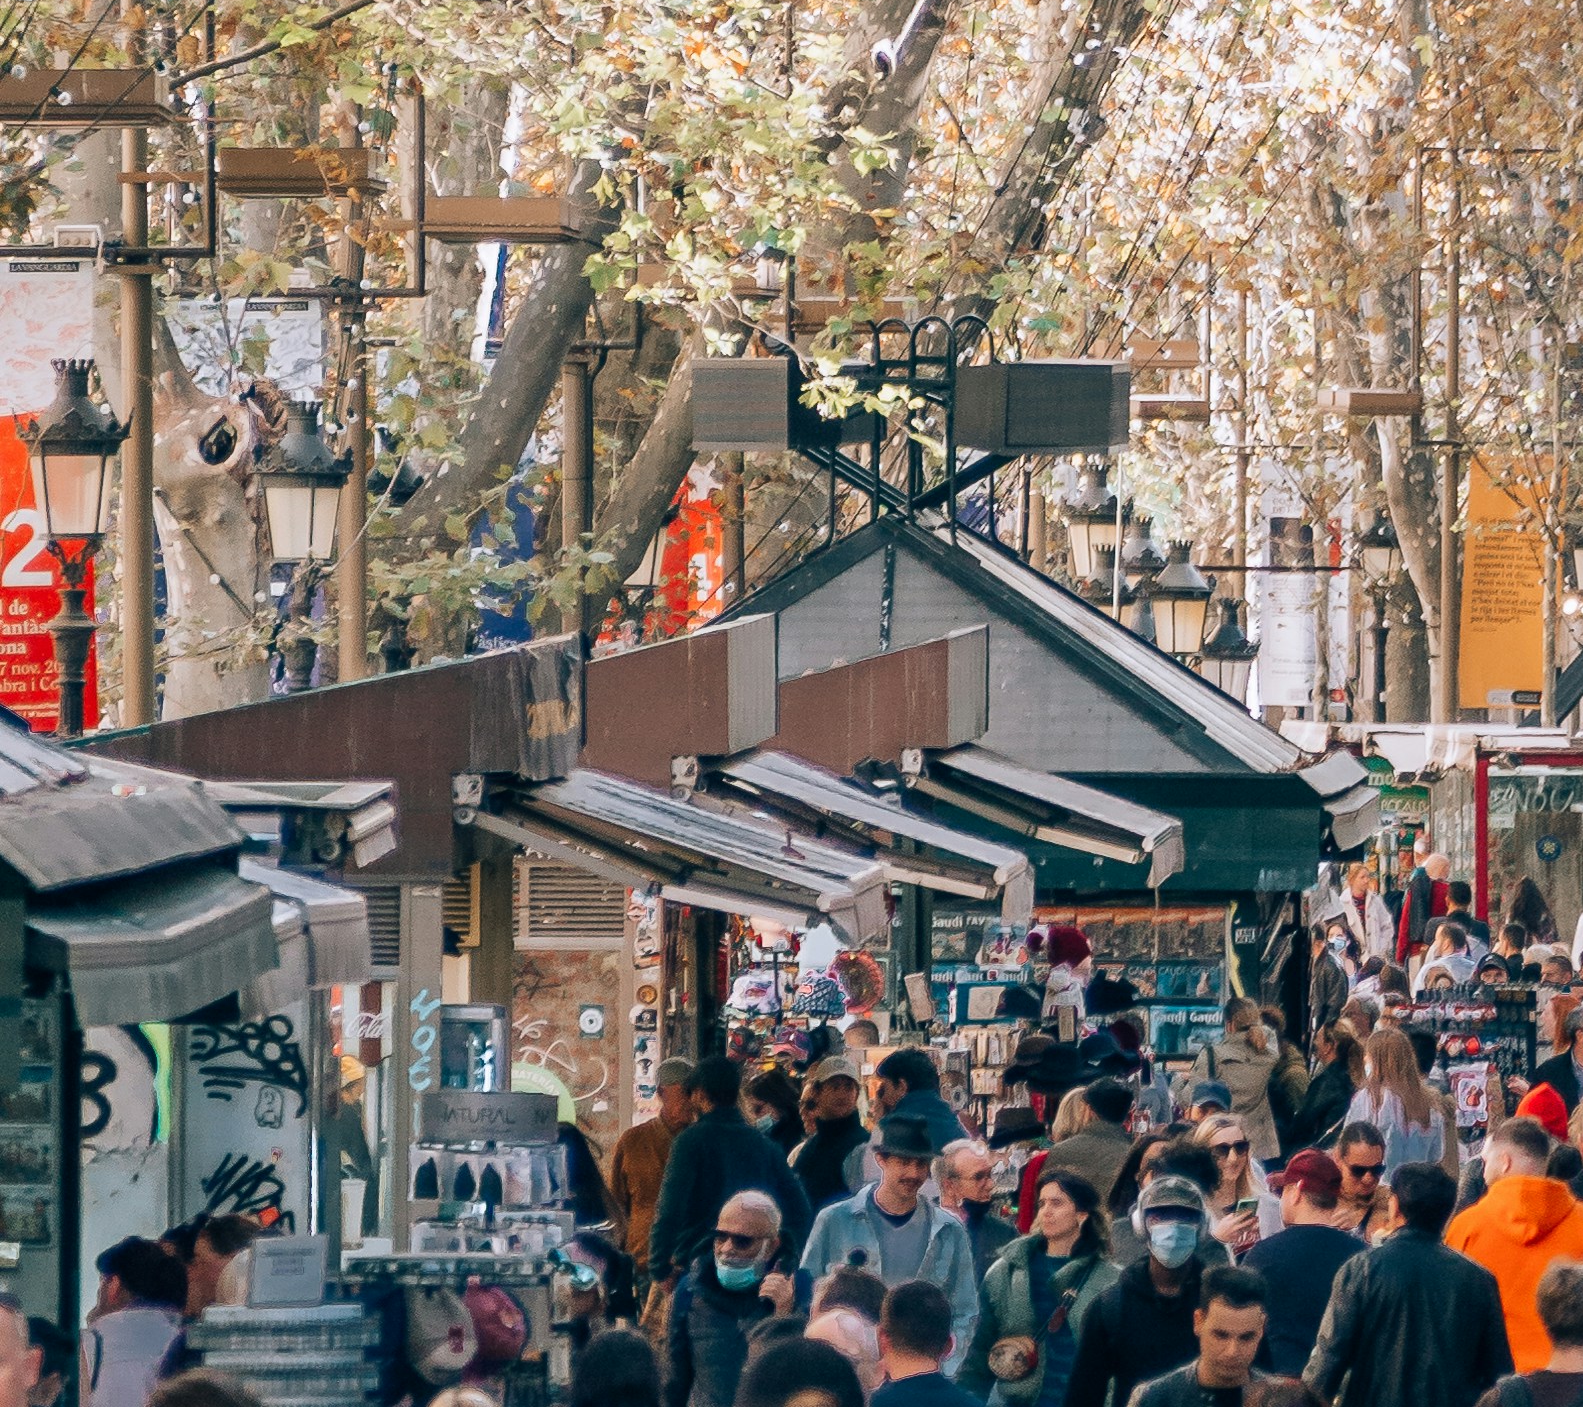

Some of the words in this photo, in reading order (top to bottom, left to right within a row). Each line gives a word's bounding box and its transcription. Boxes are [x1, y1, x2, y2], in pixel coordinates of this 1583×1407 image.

[8, 598, 28, 615] de
[11, 664, 40, 675] nov.
[31, 677, 36, 692] i
